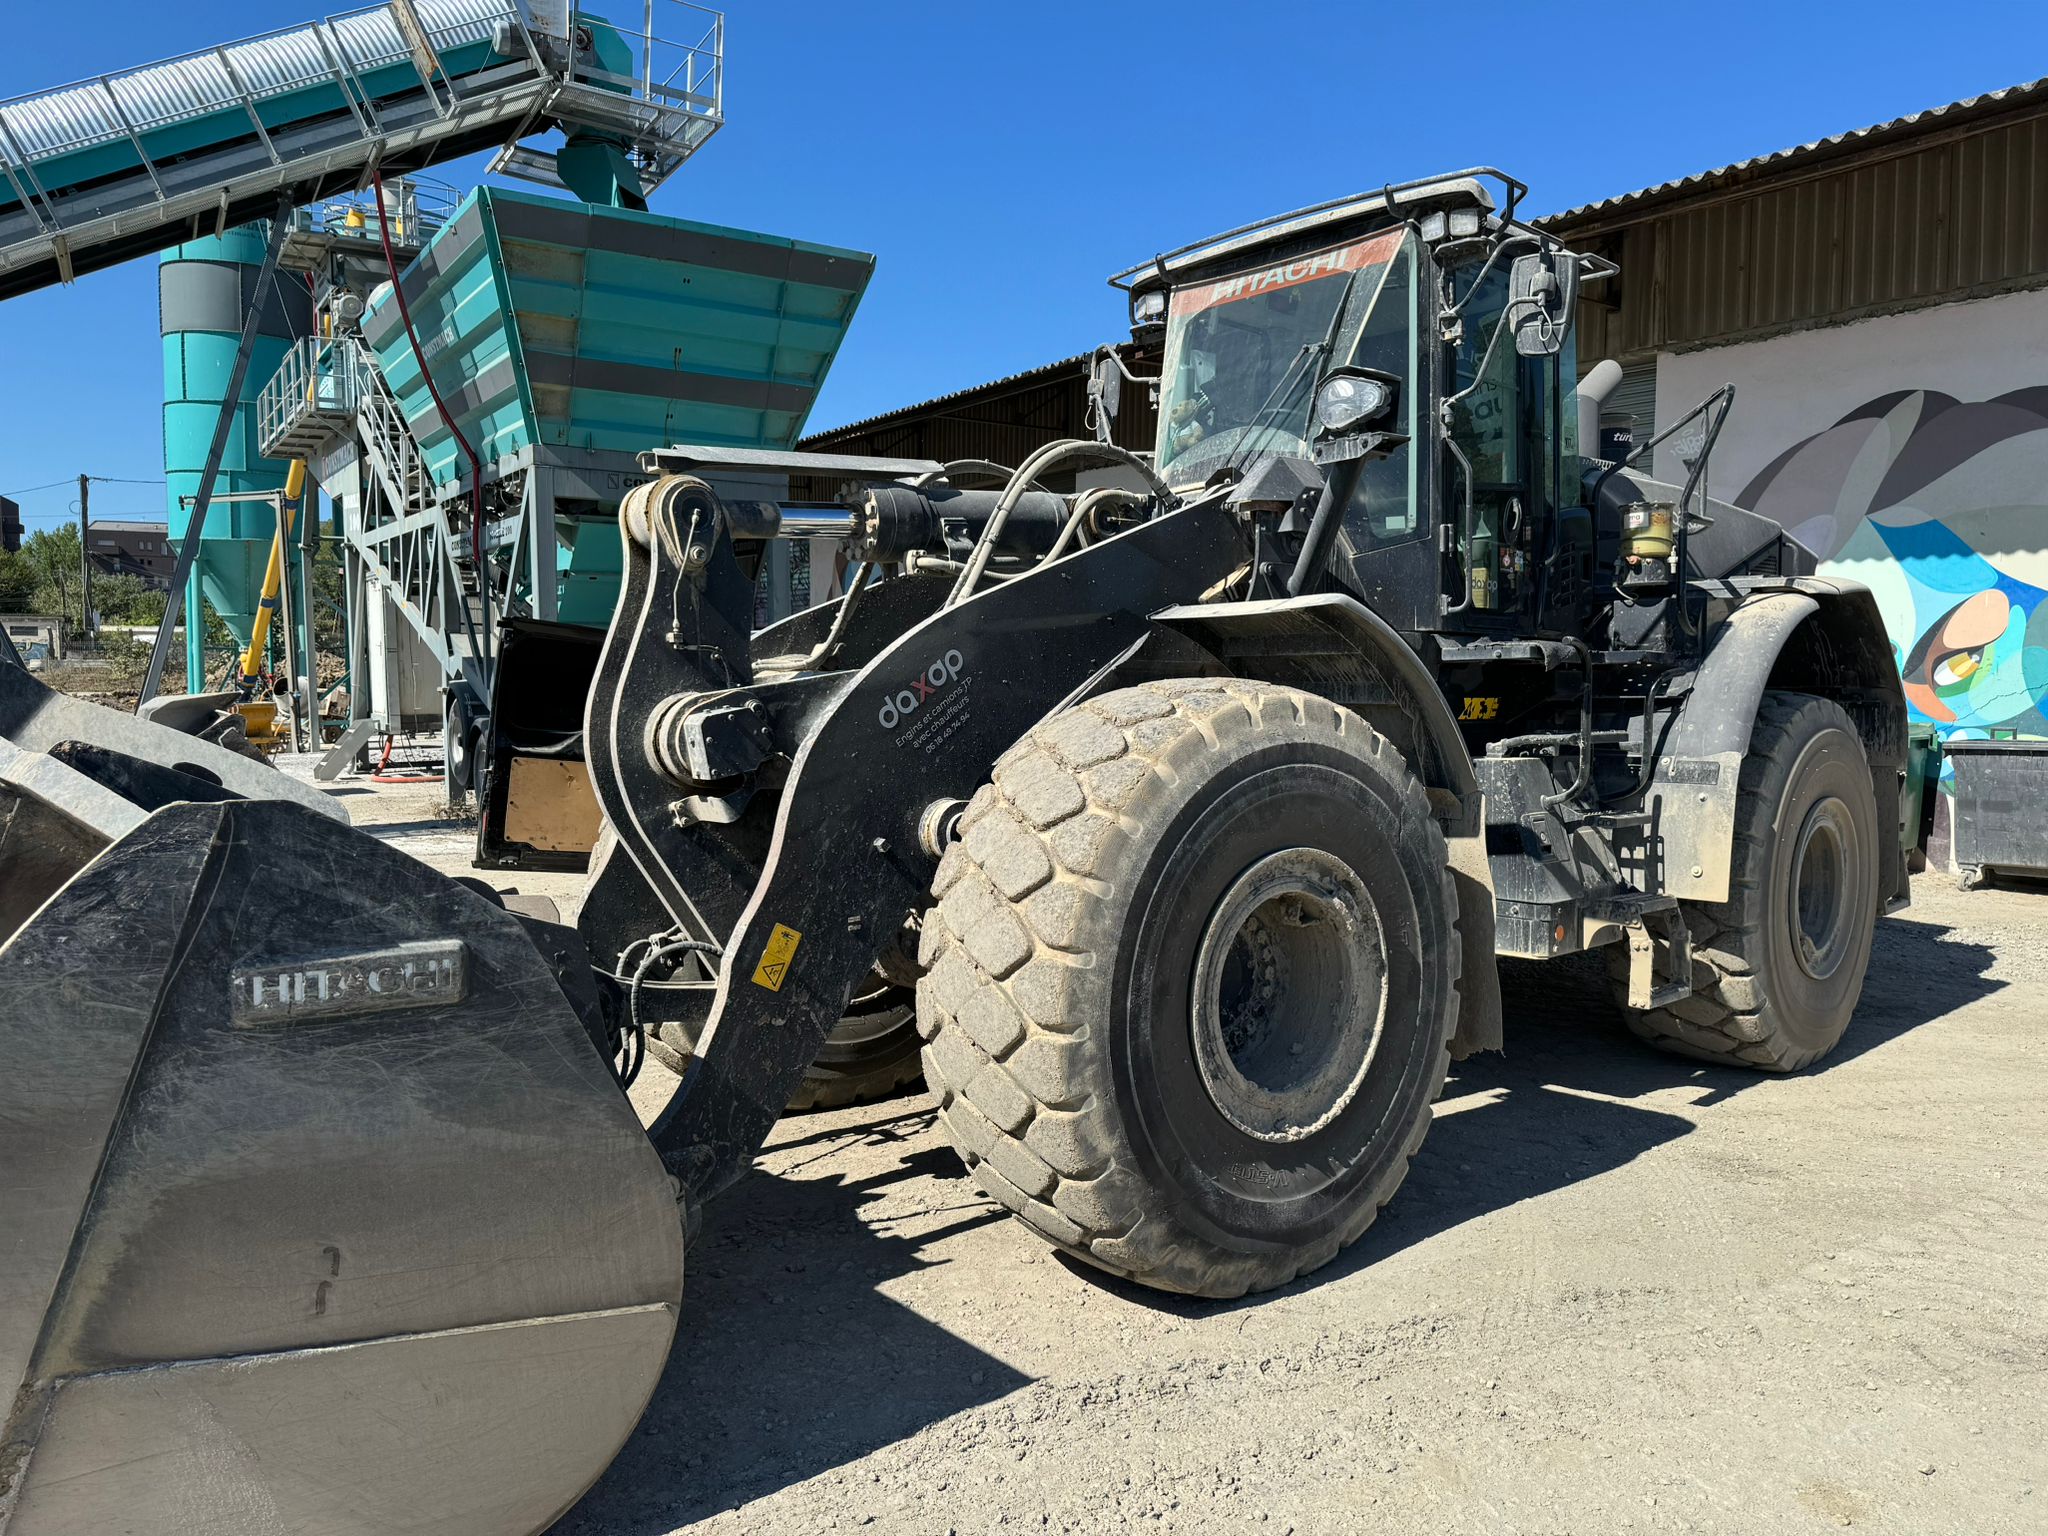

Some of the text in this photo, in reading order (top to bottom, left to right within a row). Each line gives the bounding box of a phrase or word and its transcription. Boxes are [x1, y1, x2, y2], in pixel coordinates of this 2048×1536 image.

[1210, 248, 1350, 302] HITACHI
[878, 649, 963, 729] daxap
[895, 676, 973, 748] Engins et camions TP
[912, 695, 970, 748] avec chauffeurs
[925, 742, 936, 754] 06
